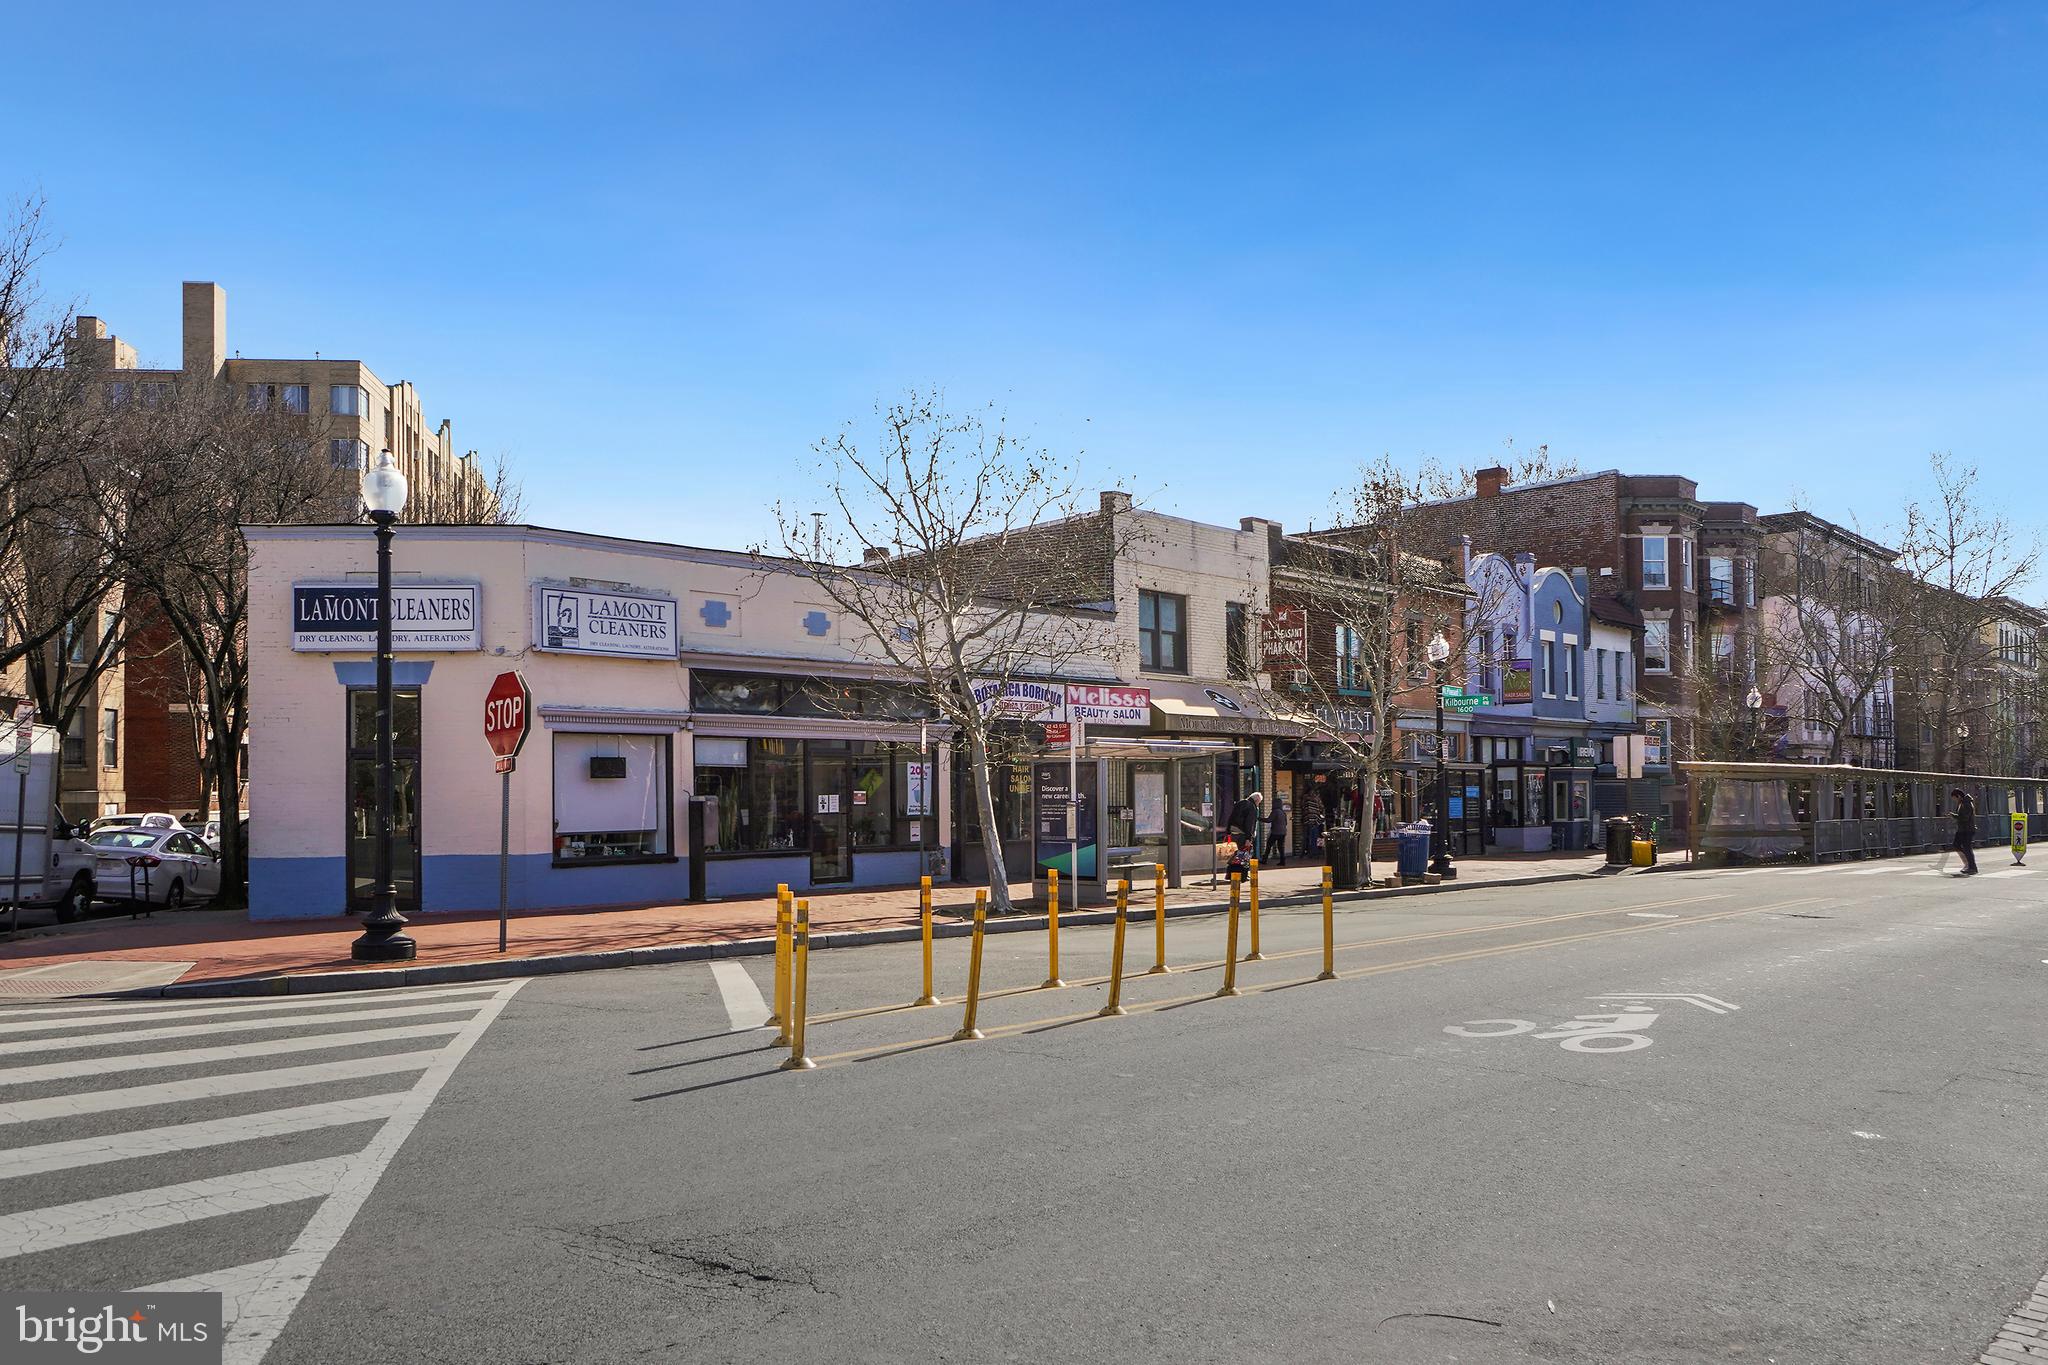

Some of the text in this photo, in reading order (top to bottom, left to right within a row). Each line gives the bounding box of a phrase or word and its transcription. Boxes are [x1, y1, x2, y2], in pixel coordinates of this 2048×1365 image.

[300, 598, 379, 621] LAMONT
[588, 599, 666, 620] LAMONT
[589, 620, 667, 639] CLEANERS
[1274, 628, 1303, 639] EASANT
[318, 635, 365, 643] CLEANING,
[368, 635, 411, 643] LADRY,
[974, 682, 1062, 708] BOTAICA BORICUA
[1067, 686, 1147, 707] Melissa
[1445, 697, 1479, 707] Kilbourne
[487, 696, 522, 732] STOP
[1074, 706, 1141, 719] BEAUTY SALON
[1420, 735, 1454, 746] DENT
[1012, 765, 1029, 773] HAIR
